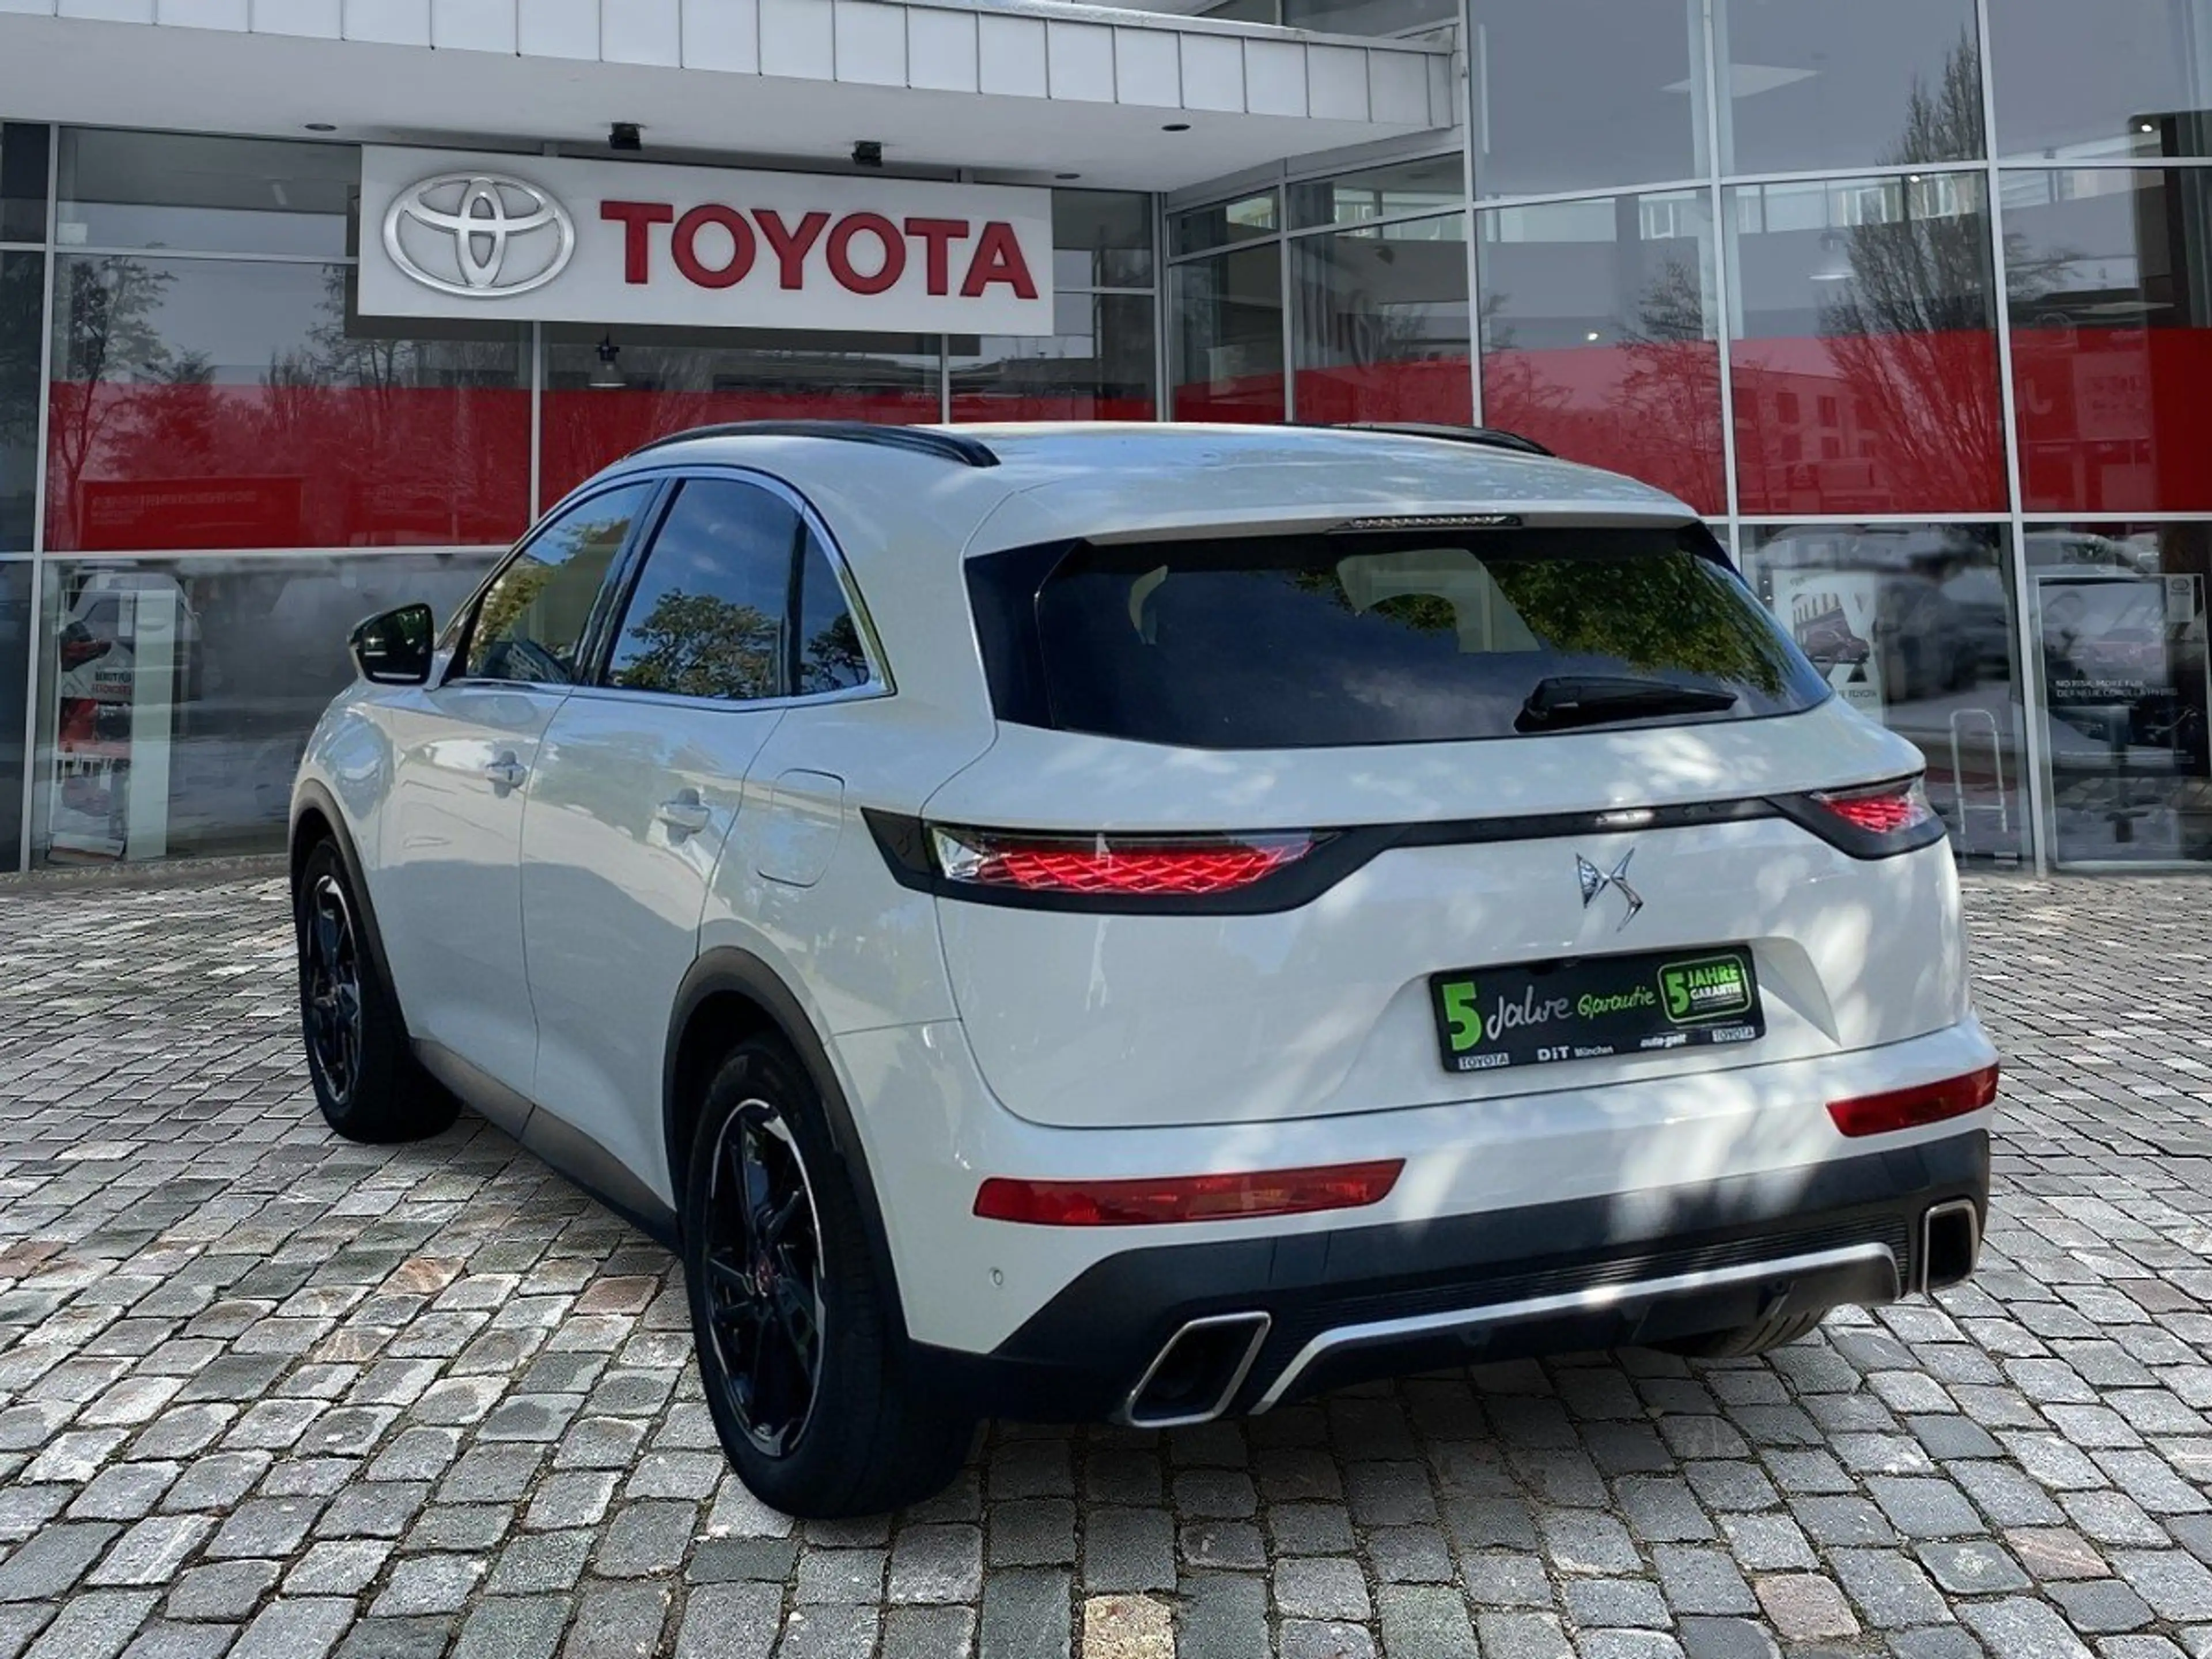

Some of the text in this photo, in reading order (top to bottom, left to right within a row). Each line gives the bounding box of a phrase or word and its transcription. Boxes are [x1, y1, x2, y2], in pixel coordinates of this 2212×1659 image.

[600, 200, 1039, 300] TOYOTA
[1688, 964, 1739, 987] JAHRE
[1666, 972, 1690, 1014] 5
[1690, 981, 1742, 1000] GARANTIE
[1442, 982, 1656, 1052] 5 Jahre Garantie
[1712, 1027, 1755, 1042] TOYOTA
[1459, 1052, 1509, 1070] TOYOTA
